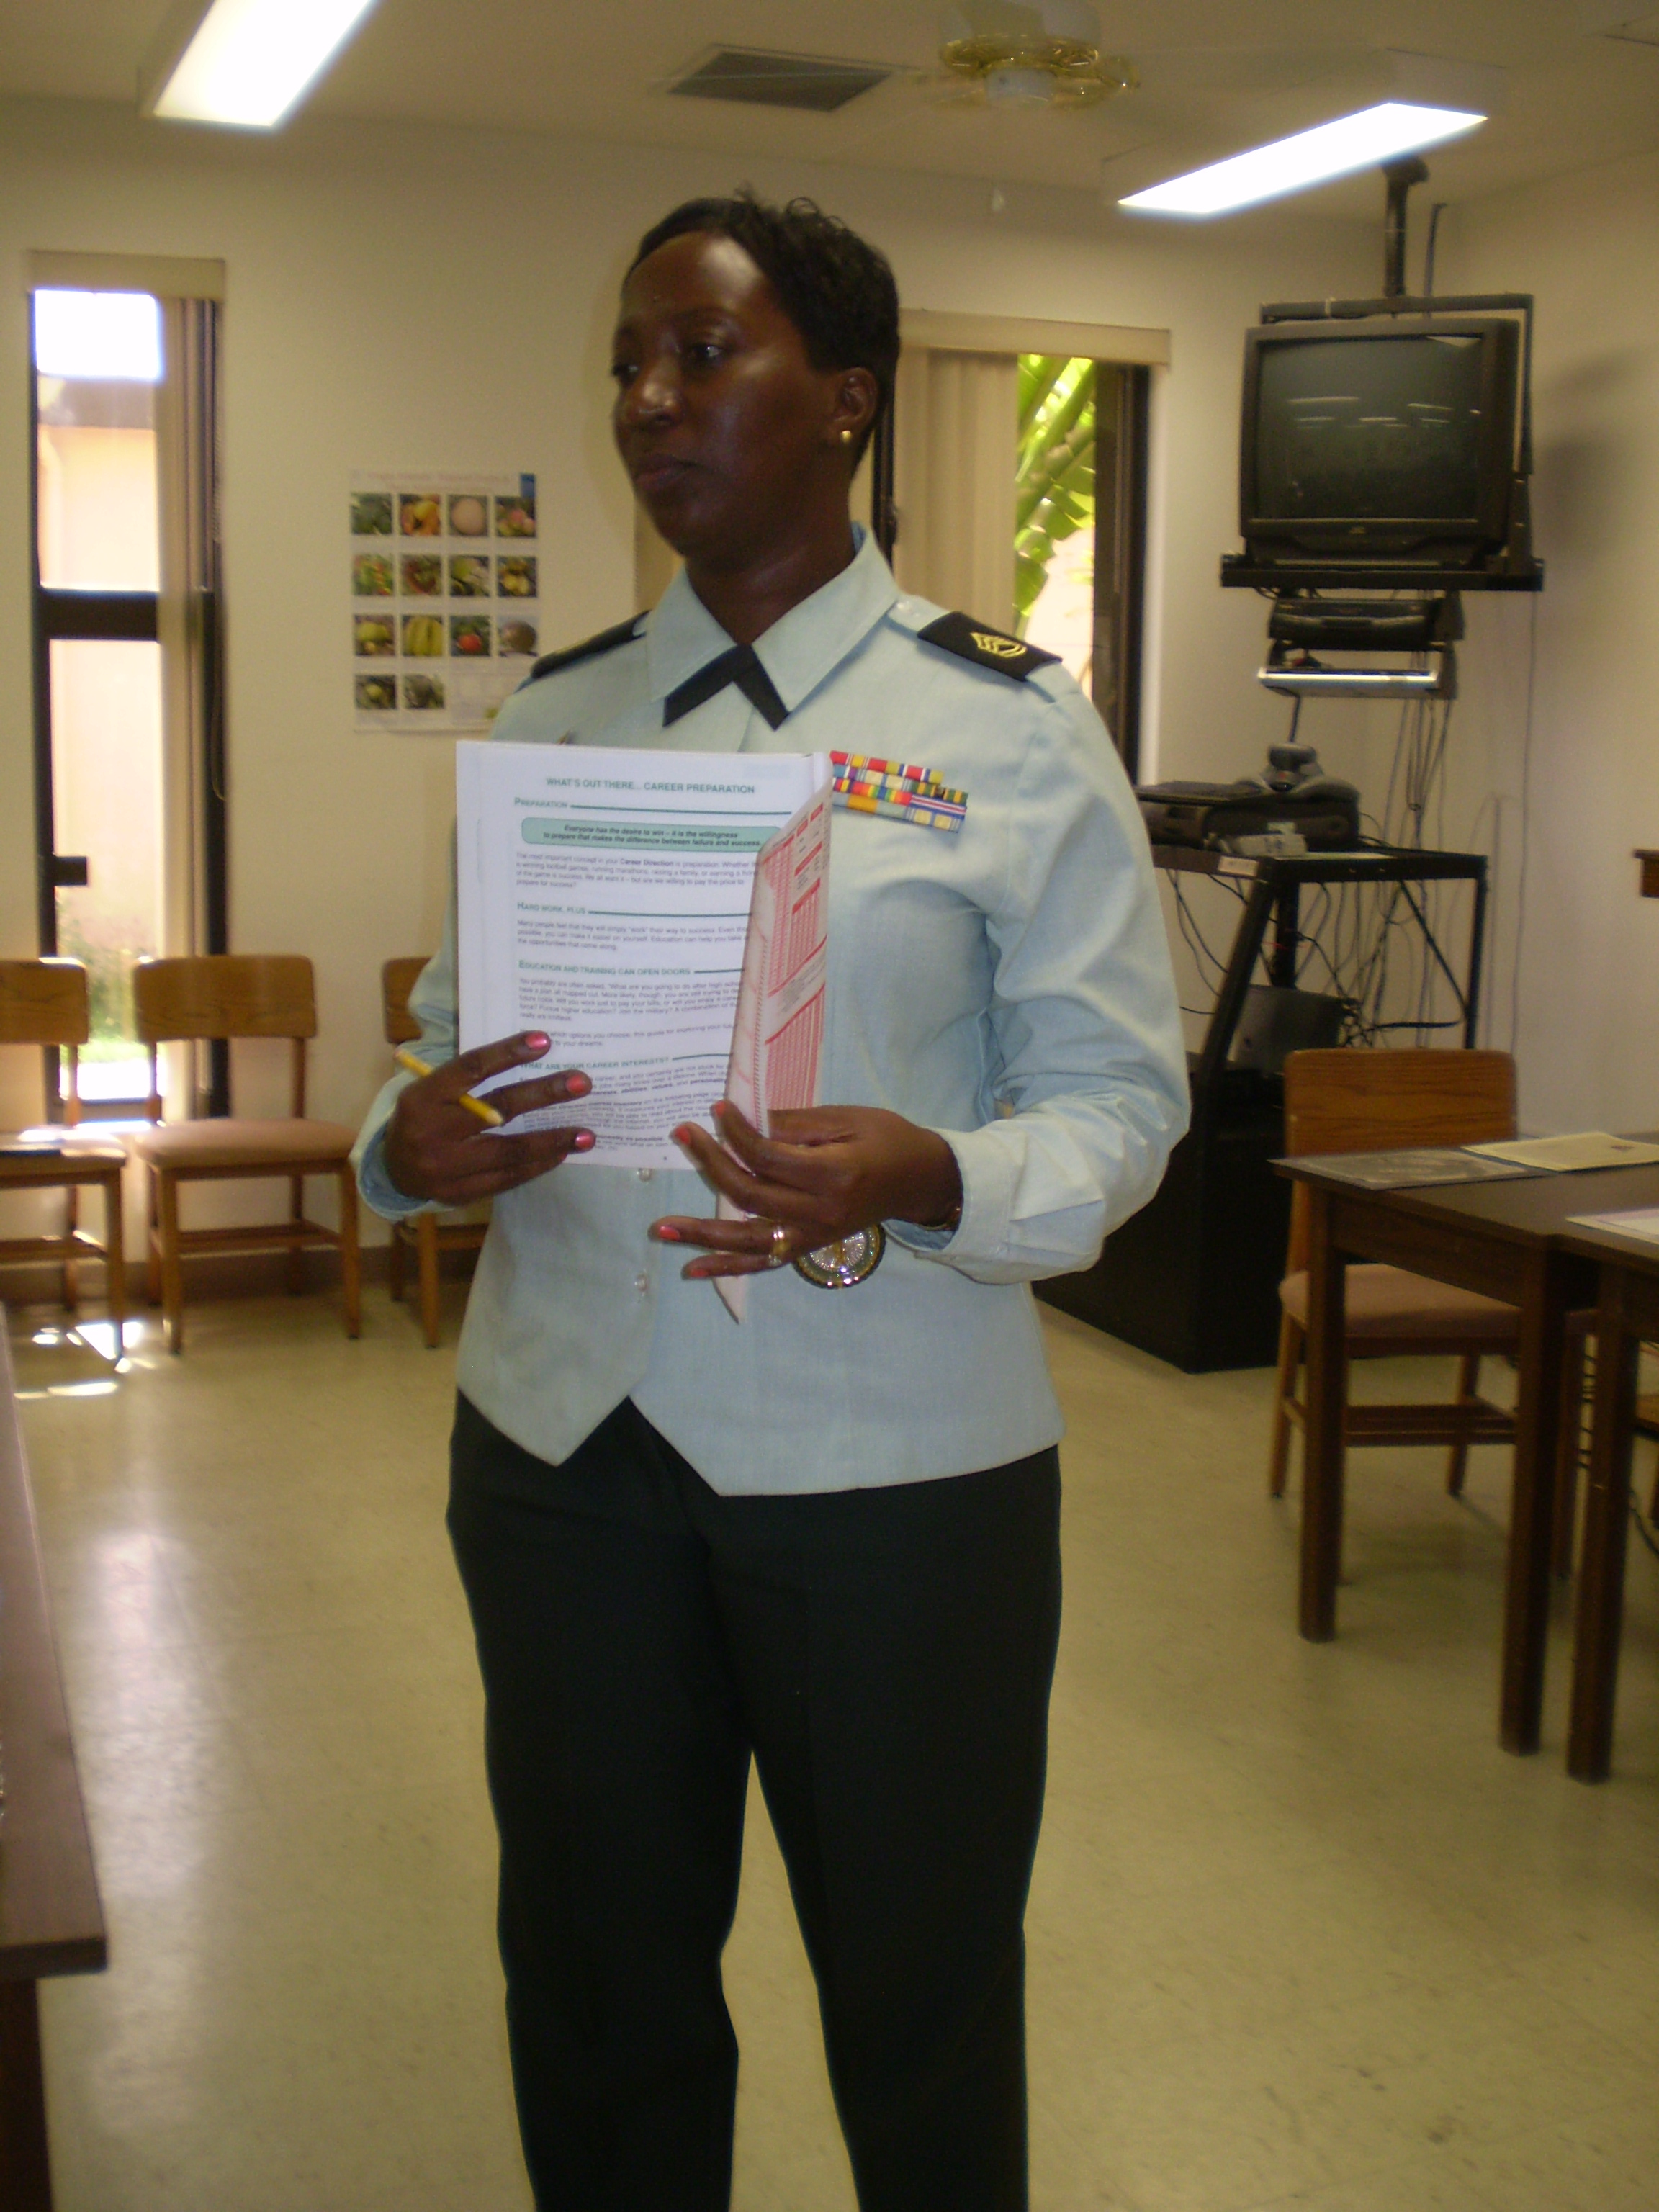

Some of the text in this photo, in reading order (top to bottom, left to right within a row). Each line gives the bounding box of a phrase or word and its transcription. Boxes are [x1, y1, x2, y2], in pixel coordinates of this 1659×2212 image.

[547, 779, 580, 788] WHAT'S
[583, 780, 601, 788] OUT
[644, 782, 683, 791] CAREER
[687, 783, 755, 794] PREPARATION
[564, 824, 595, 834] Everyone
[698, 830, 738, 840] willingness
[552, 832, 576, 841] prepare
[626, 835, 660, 844] difference
[661, 837, 691, 845] between
[692, 837, 714, 846] failure
[719, 878, 736, 886] price
[517, 902, 540, 912] HARD
[651, 935, 683, 943] Education
[518, 959, 562, 972] EDUCATION
[563, 964, 580, 973] AND
[580, 966, 616, 976] TRAINING
[545, 1062, 561, 1072] ARE
[563, 1062, 585, 1071] YOUR
[586, 1061, 619, 1071] CAREER
